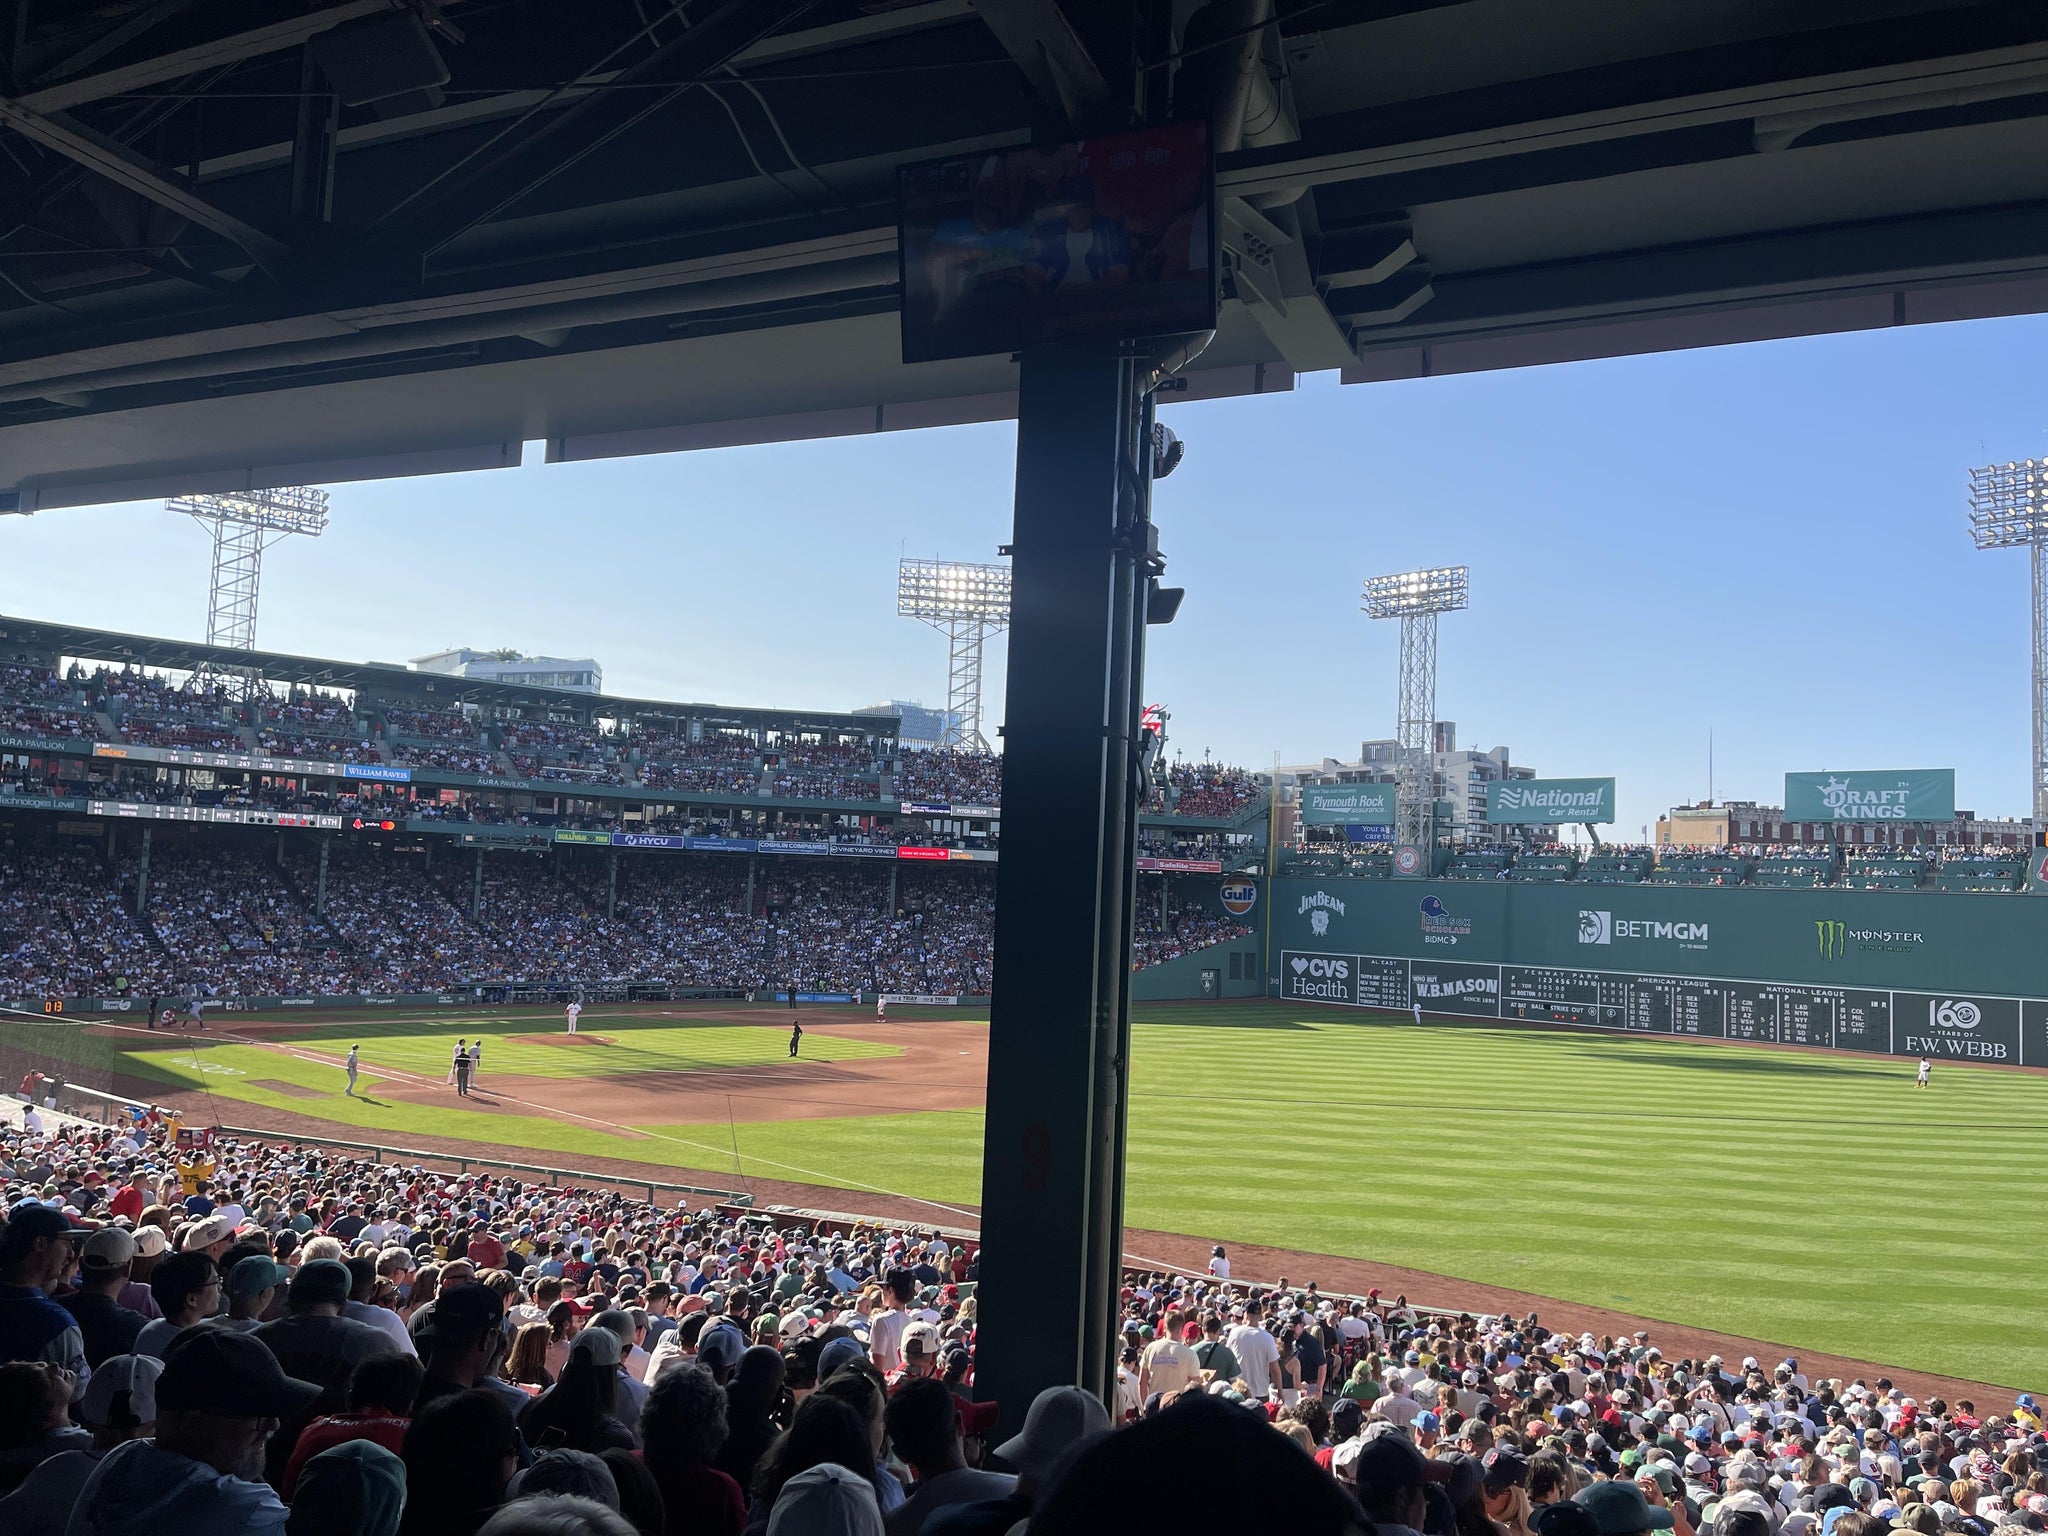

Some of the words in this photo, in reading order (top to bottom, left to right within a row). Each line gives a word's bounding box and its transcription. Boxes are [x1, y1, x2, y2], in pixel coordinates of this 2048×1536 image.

[26, 740, 64, 750] PAVILION
[349, 768, 383, 777] WILLIAM
[1312, 795, 1357, 809] Plymouth
[1359, 795, 1384, 807] Rock
[1823, 789, 1909, 807] DRAFT
[1549, 808, 1565, 816] Car
[1568, 808, 1598, 816] Rental
[1834, 805, 1907, 818] KINGS
[322, 818, 338, 826] 6TH
[558, 833, 586, 841] SULLIVAN
[639, 837, 669, 845] HYCU
[1221, 886, 1254, 901] Gulf
[1425, 917, 1447, 926] RED
[1449, 918, 1471, 927] SOX
[1616, 920, 1708, 940] BETMGM
[1849, 929, 1924, 943] MONSTER
[1425, 936, 1449, 944] BIDMC
[1309, 959, 1348, 979] CVS
[1292, 977, 1348, 998] Health
[1637, 977, 1676, 985] AMERICAN
[1679, 980, 1710, 988] LEAGUE
[1766, 986, 1808, 995] NATIONAL
[1811, 989, 1845, 997] LEAGUE
[1929, 999, 1981, 1029] 160
[1905, 1036, 1940, 1053] F.W.
[1945, 1039, 2007, 1058] WEBB
